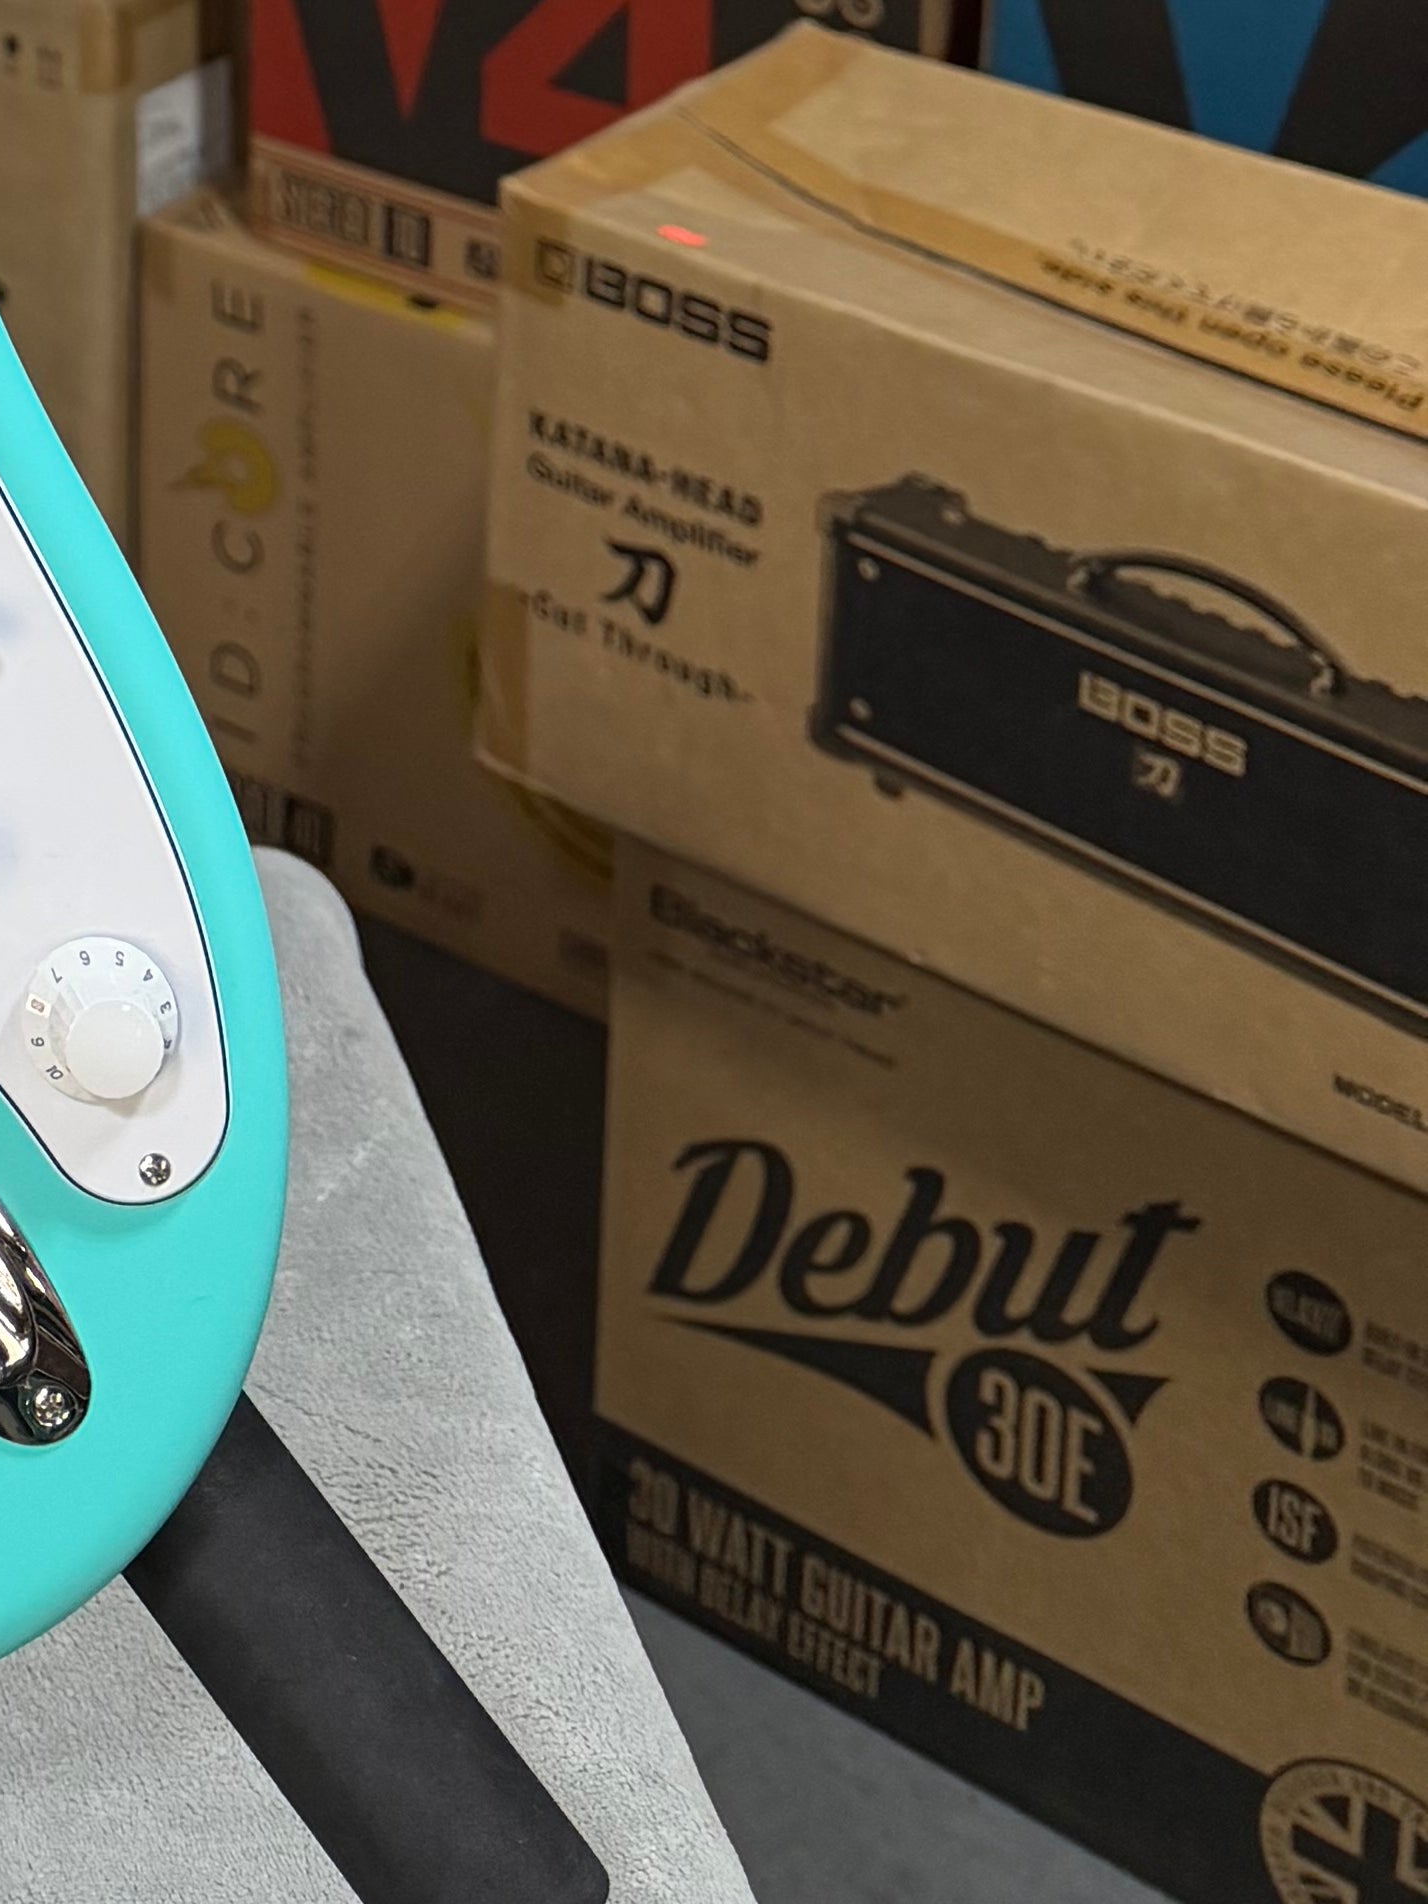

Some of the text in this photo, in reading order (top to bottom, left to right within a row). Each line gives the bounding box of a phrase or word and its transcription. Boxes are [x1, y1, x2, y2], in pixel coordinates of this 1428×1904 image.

[583, 254, 773, 364] BOSS
[1197, 316, 1290, 360] open
[1299, 354, 1424, 412] Please
[526, 450, 759, 568] Guitar Amplifier
[527, 408, 765, 528] KATANA-HEAD
[603, 537, 677, 625] 刀
[1076, 668, 1248, 779] BOSS
[50, 967, 64, 984] 7
[78, 950, 91, 966] 6
[114, 950, 125, 967] 5
[142, 968, 154, 982] 4
[649, 883, 909, 1016] Blackstar
[45, 1064, 65, 1081] 10
[647, 1137, 1204, 1354] Debut
[975, 1368, 1103, 1526] 30E
[1264, 1482, 1324, 1557] ISF
[627, 1454, 1045, 1732] 30 WATT GUITAR AMP
[785, 1602, 884, 1700] EFFECT
